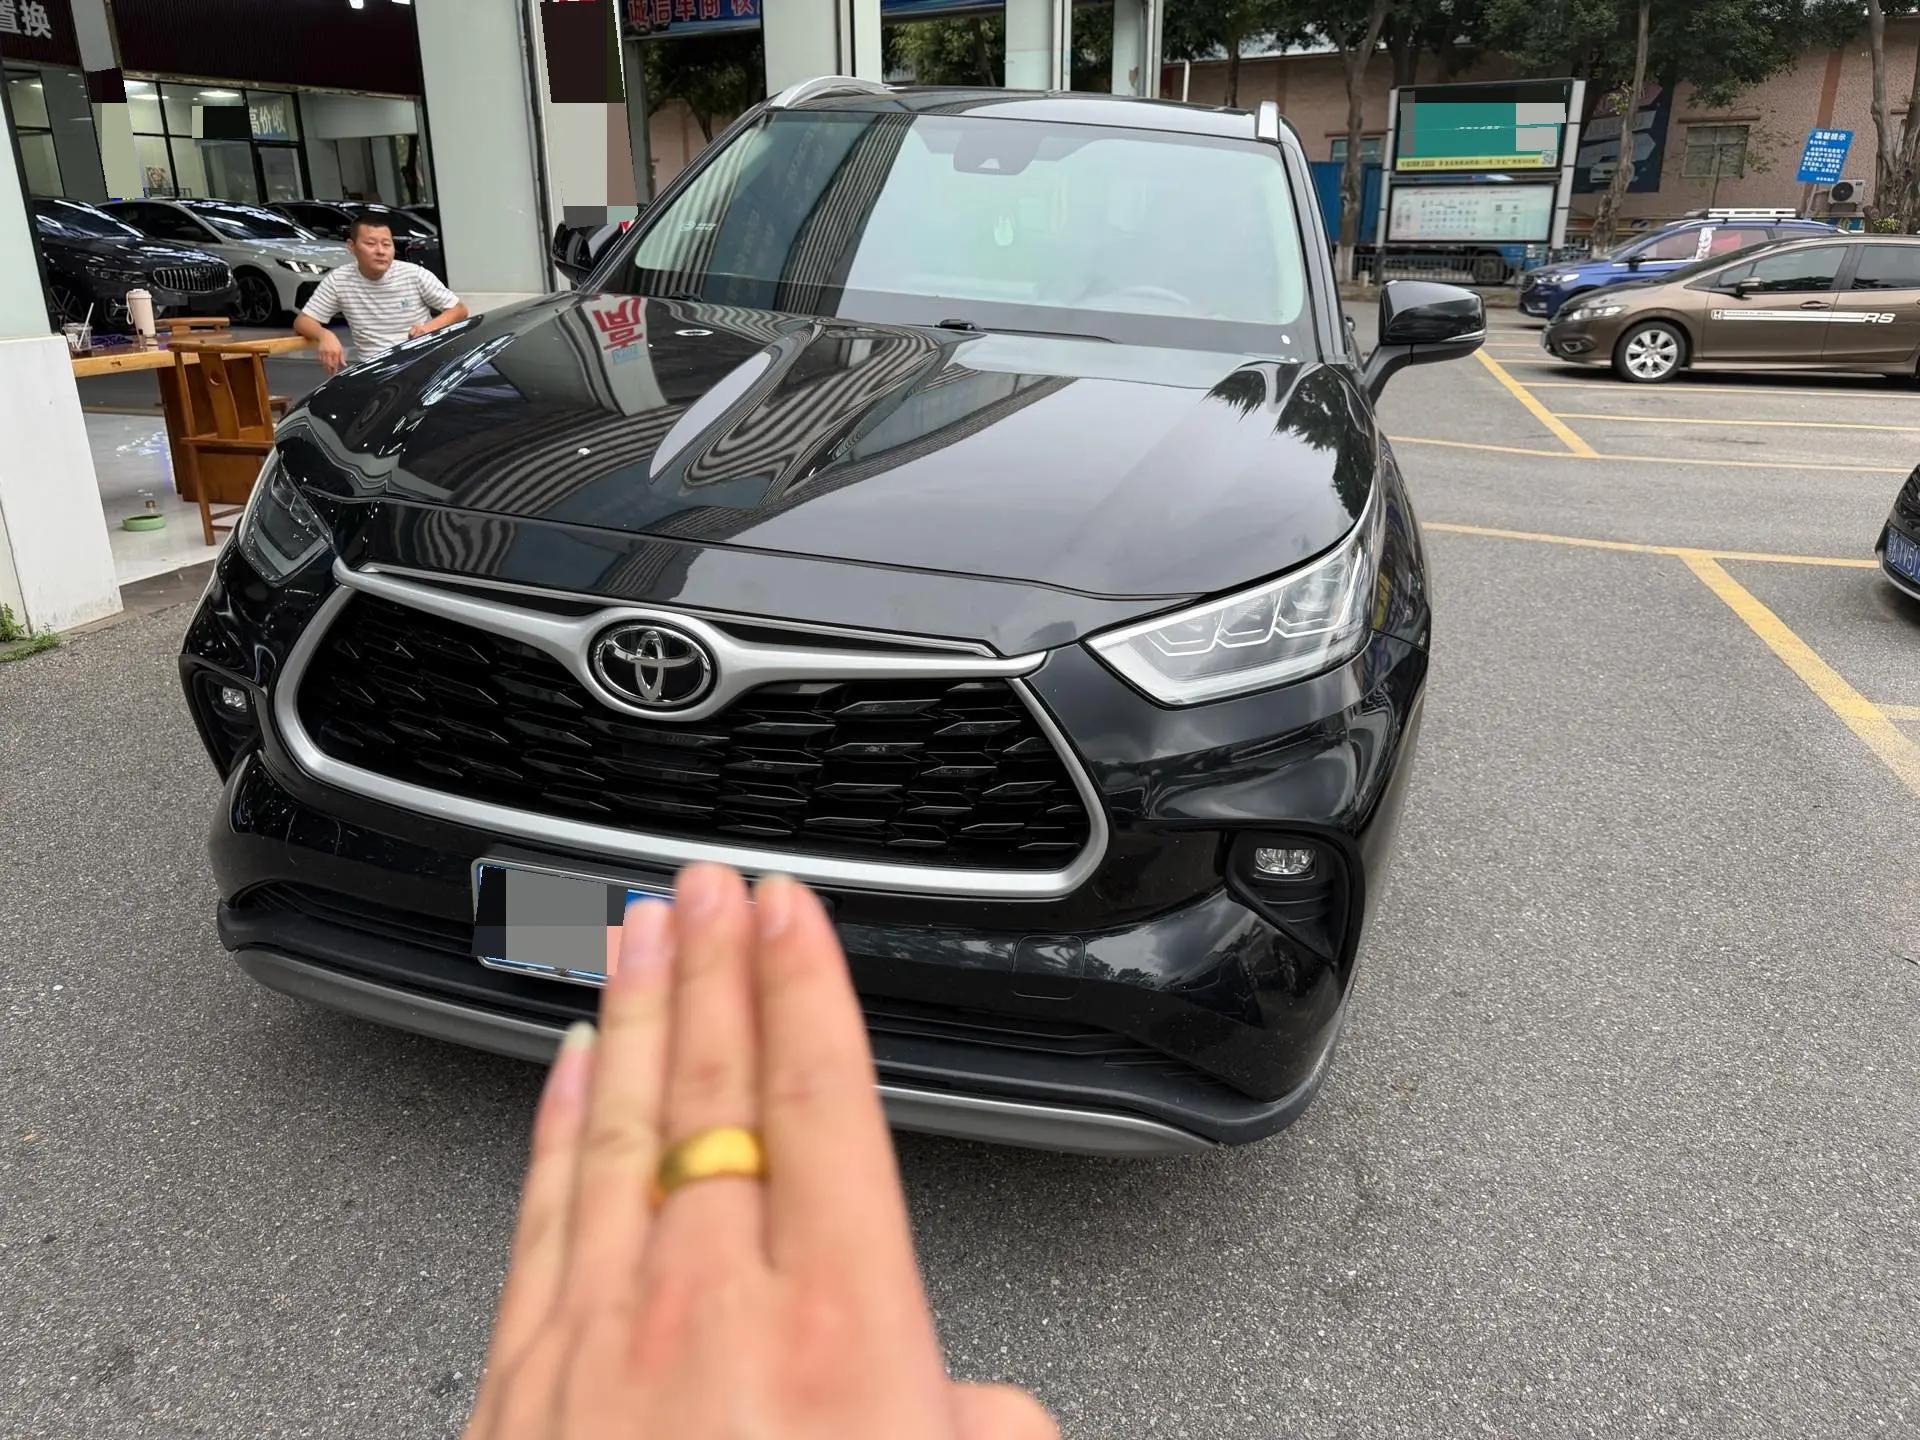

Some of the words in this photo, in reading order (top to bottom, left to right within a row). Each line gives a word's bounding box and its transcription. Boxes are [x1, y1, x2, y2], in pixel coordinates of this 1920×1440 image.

[0, 0, 52, 40] 置换
[1815, 131, 1847, 141] 温馨提示
[1863, 312, 1897, 324] RS
